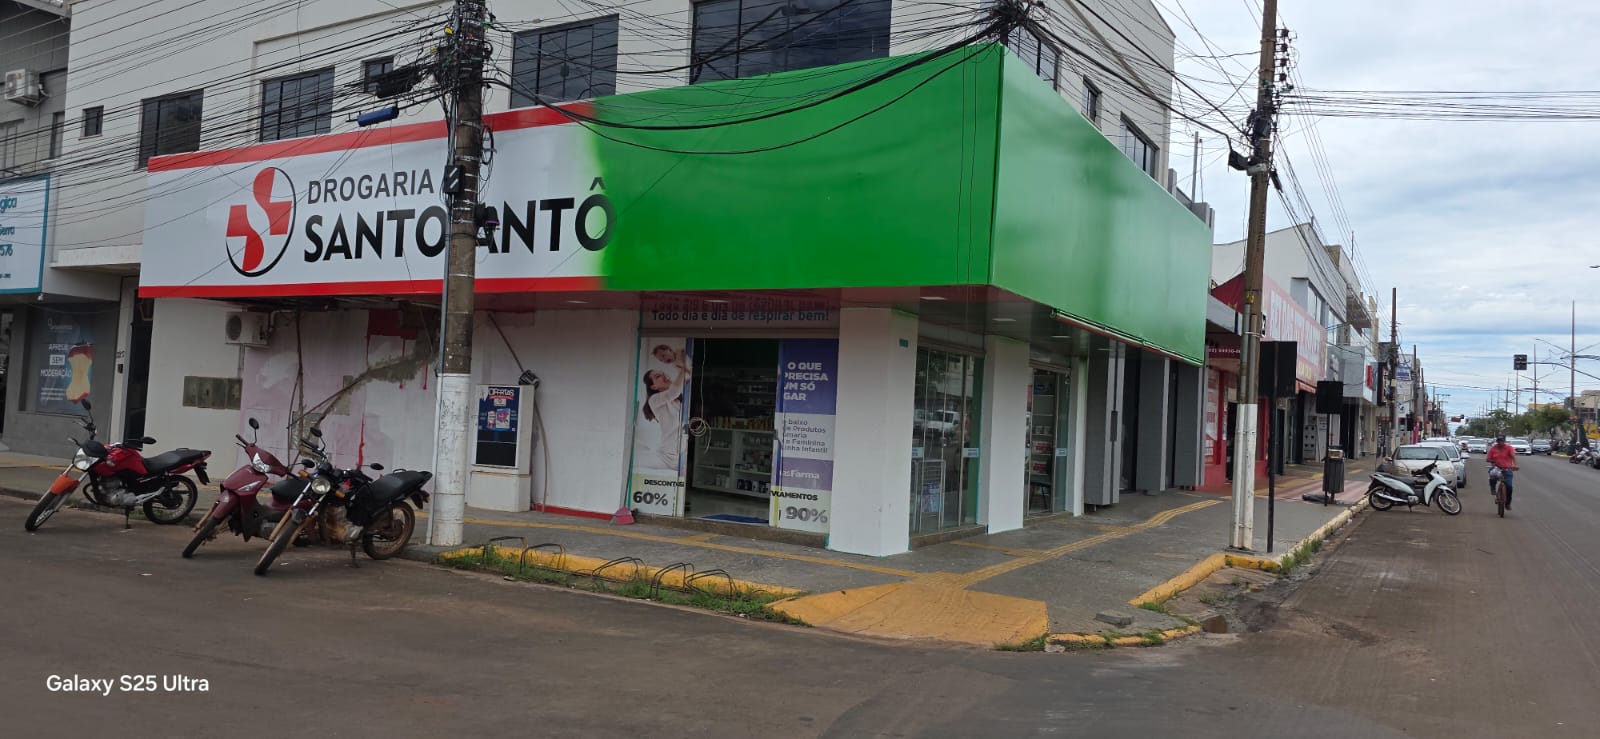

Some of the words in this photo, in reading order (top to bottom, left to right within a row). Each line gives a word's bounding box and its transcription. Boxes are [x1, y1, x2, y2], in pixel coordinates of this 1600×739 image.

[308, 169, 434, 204] DROGARIA
[303, 206, 447, 263] SANTO
[787, 362, 796, 370] O
[798, 362, 822, 370] QUE
[800, 381, 815, 391] SÓ
[633, 491, 668, 506] 60%
[786, 506, 828, 524] 90%
